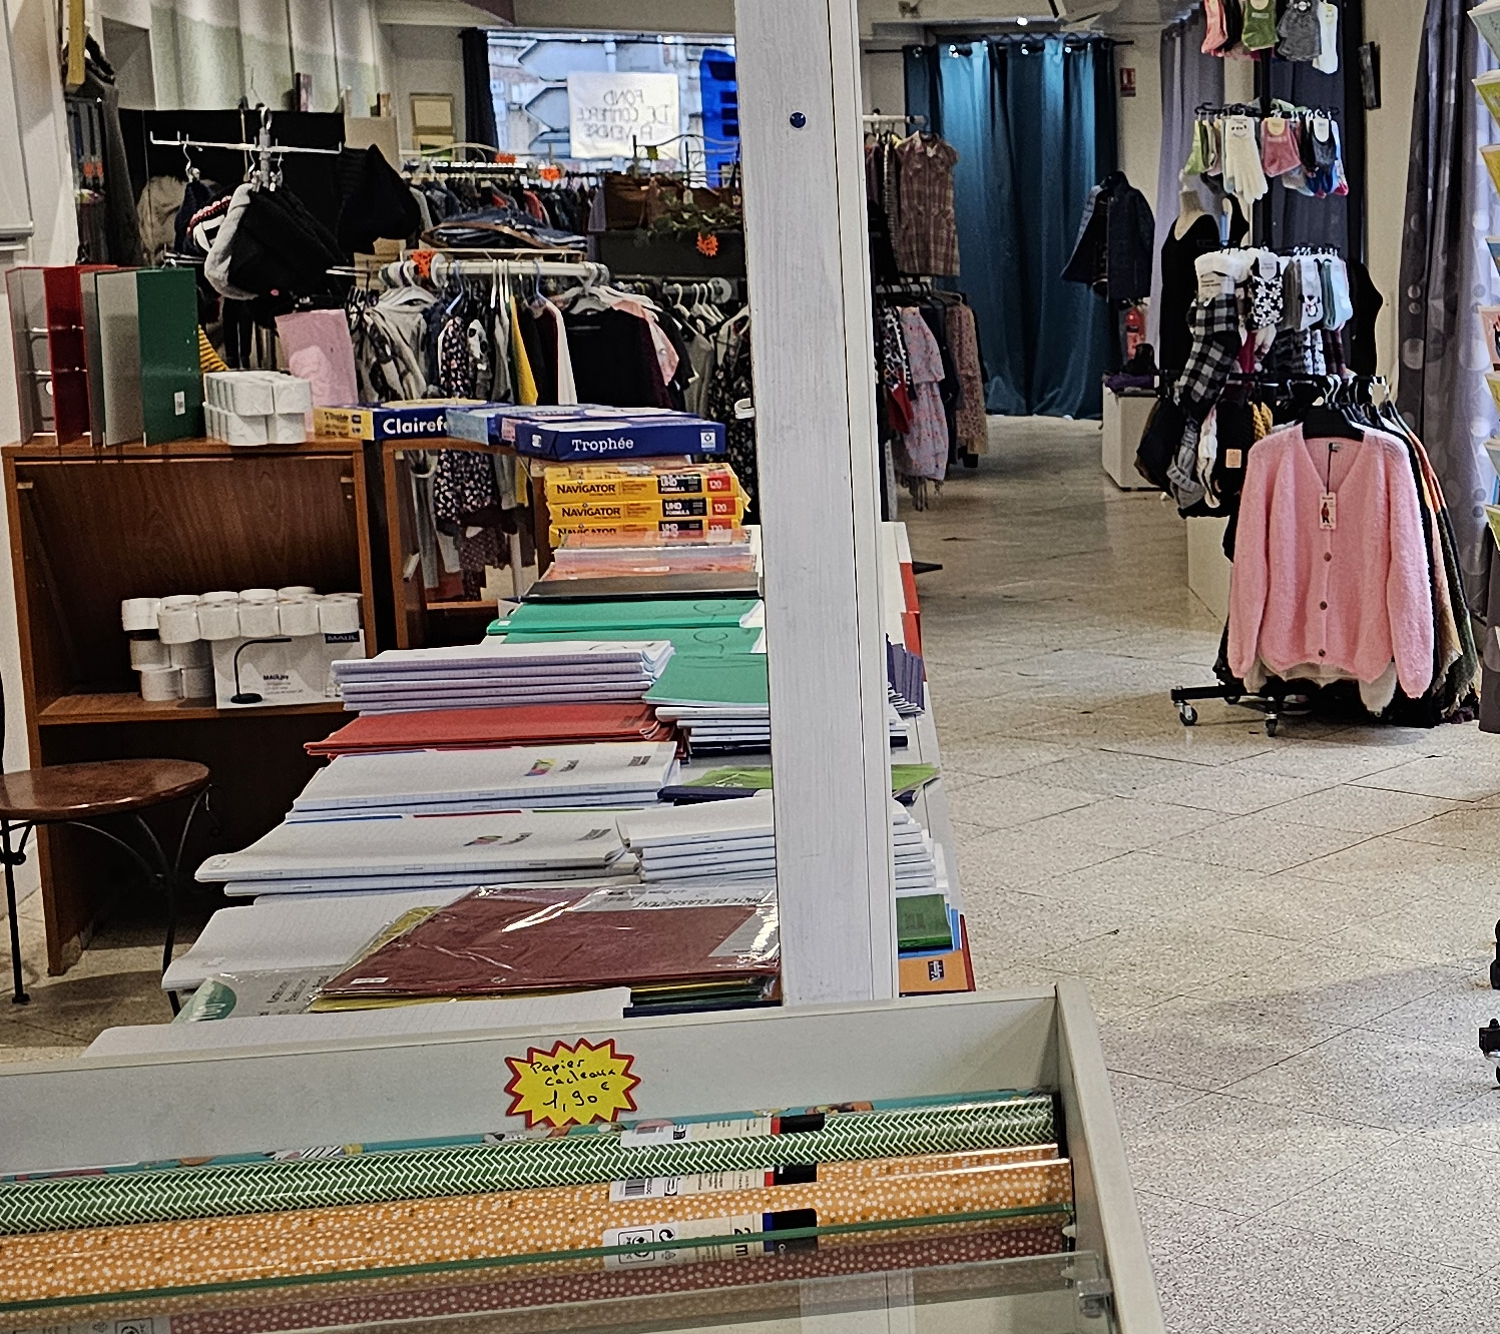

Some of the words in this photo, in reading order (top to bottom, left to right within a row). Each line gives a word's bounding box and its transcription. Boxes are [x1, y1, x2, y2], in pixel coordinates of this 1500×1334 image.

[383, 416, 448, 434] Clairef
[572, 436, 634, 453] Trophée
[557, 484, 616, 495] NAVIGATOR
[562, 507, 621, 518] NAVIGATOR
[714, 503, 727, 513] 120
[530, 1059, 585, 1075] Papier
